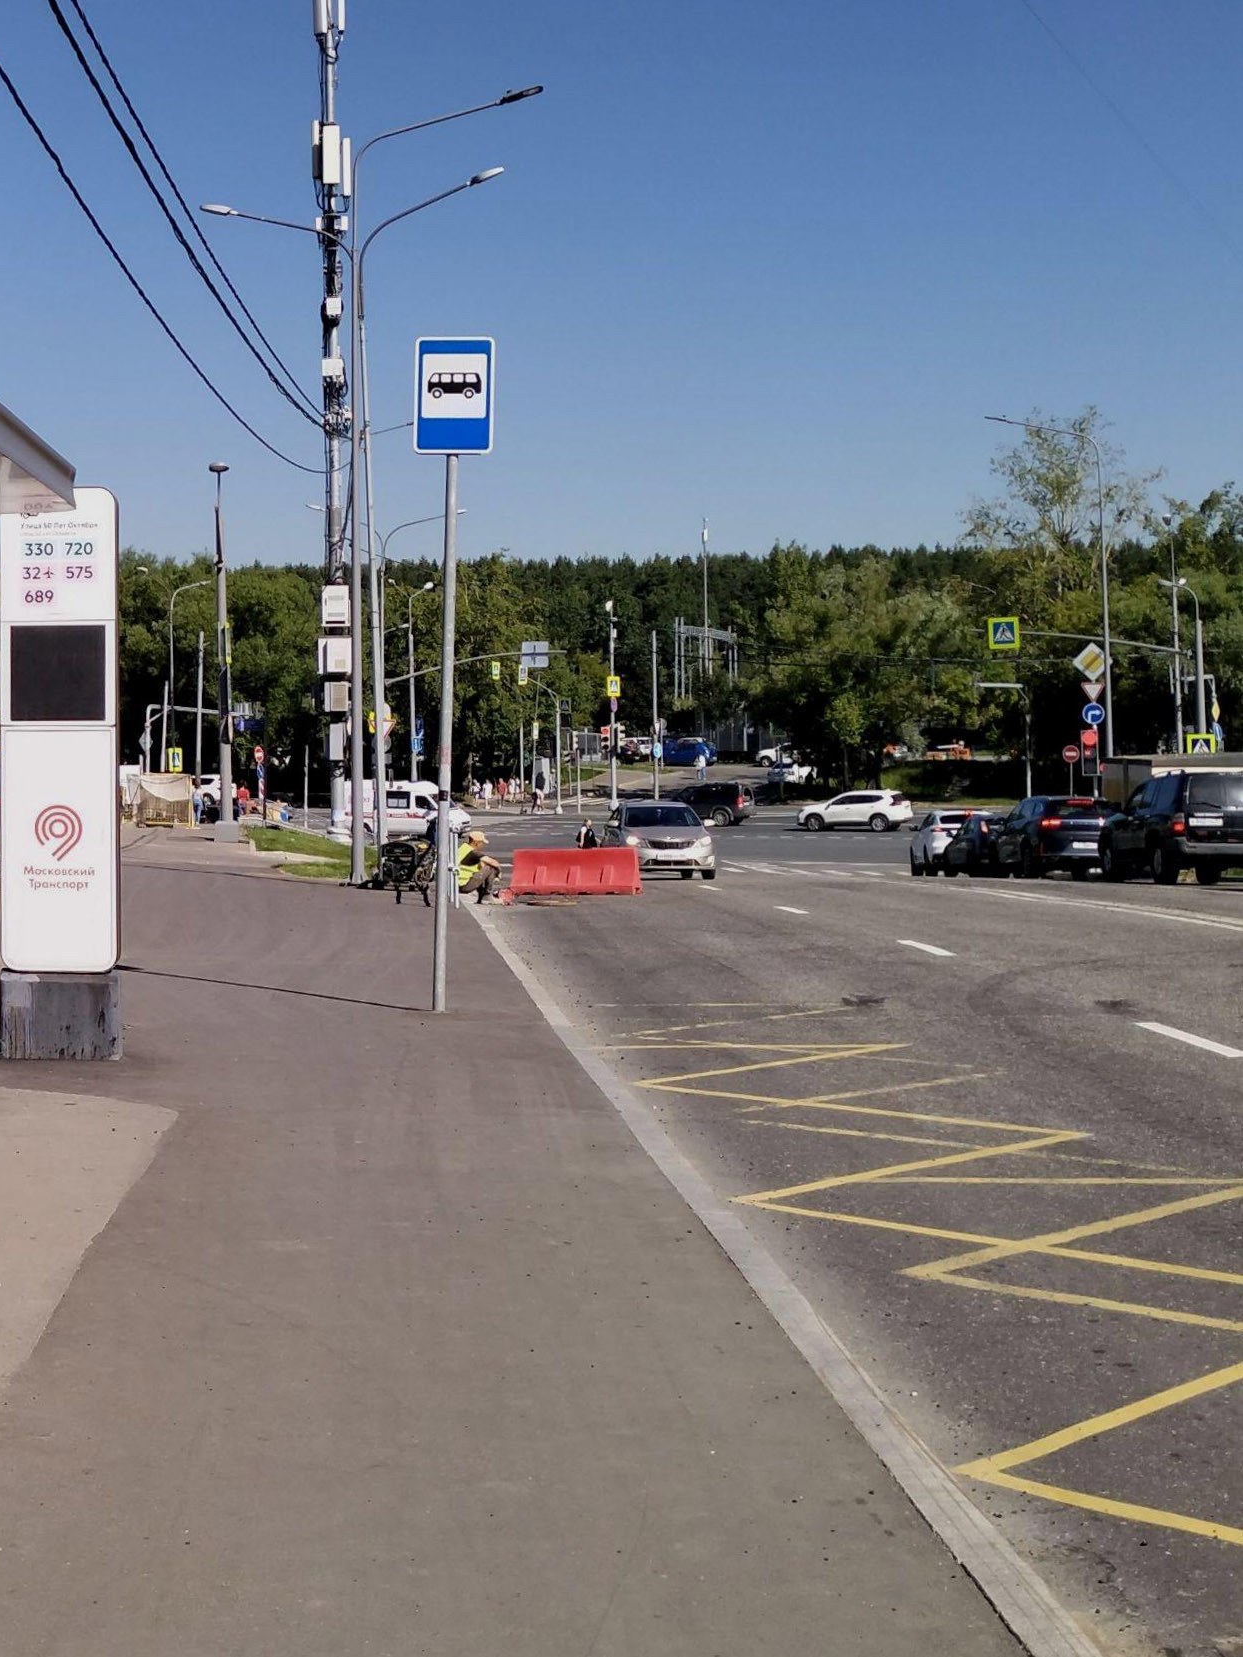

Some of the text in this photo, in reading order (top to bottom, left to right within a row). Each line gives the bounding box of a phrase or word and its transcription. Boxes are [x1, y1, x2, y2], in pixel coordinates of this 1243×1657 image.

[25, 542, 93, 556] 330 720
[22, 566, 93, 580] 32 575
[24, 590, 54, 603] 689
[23, 865, 95, 876] Московский
[28, 879, 90, 892] Транспорт
